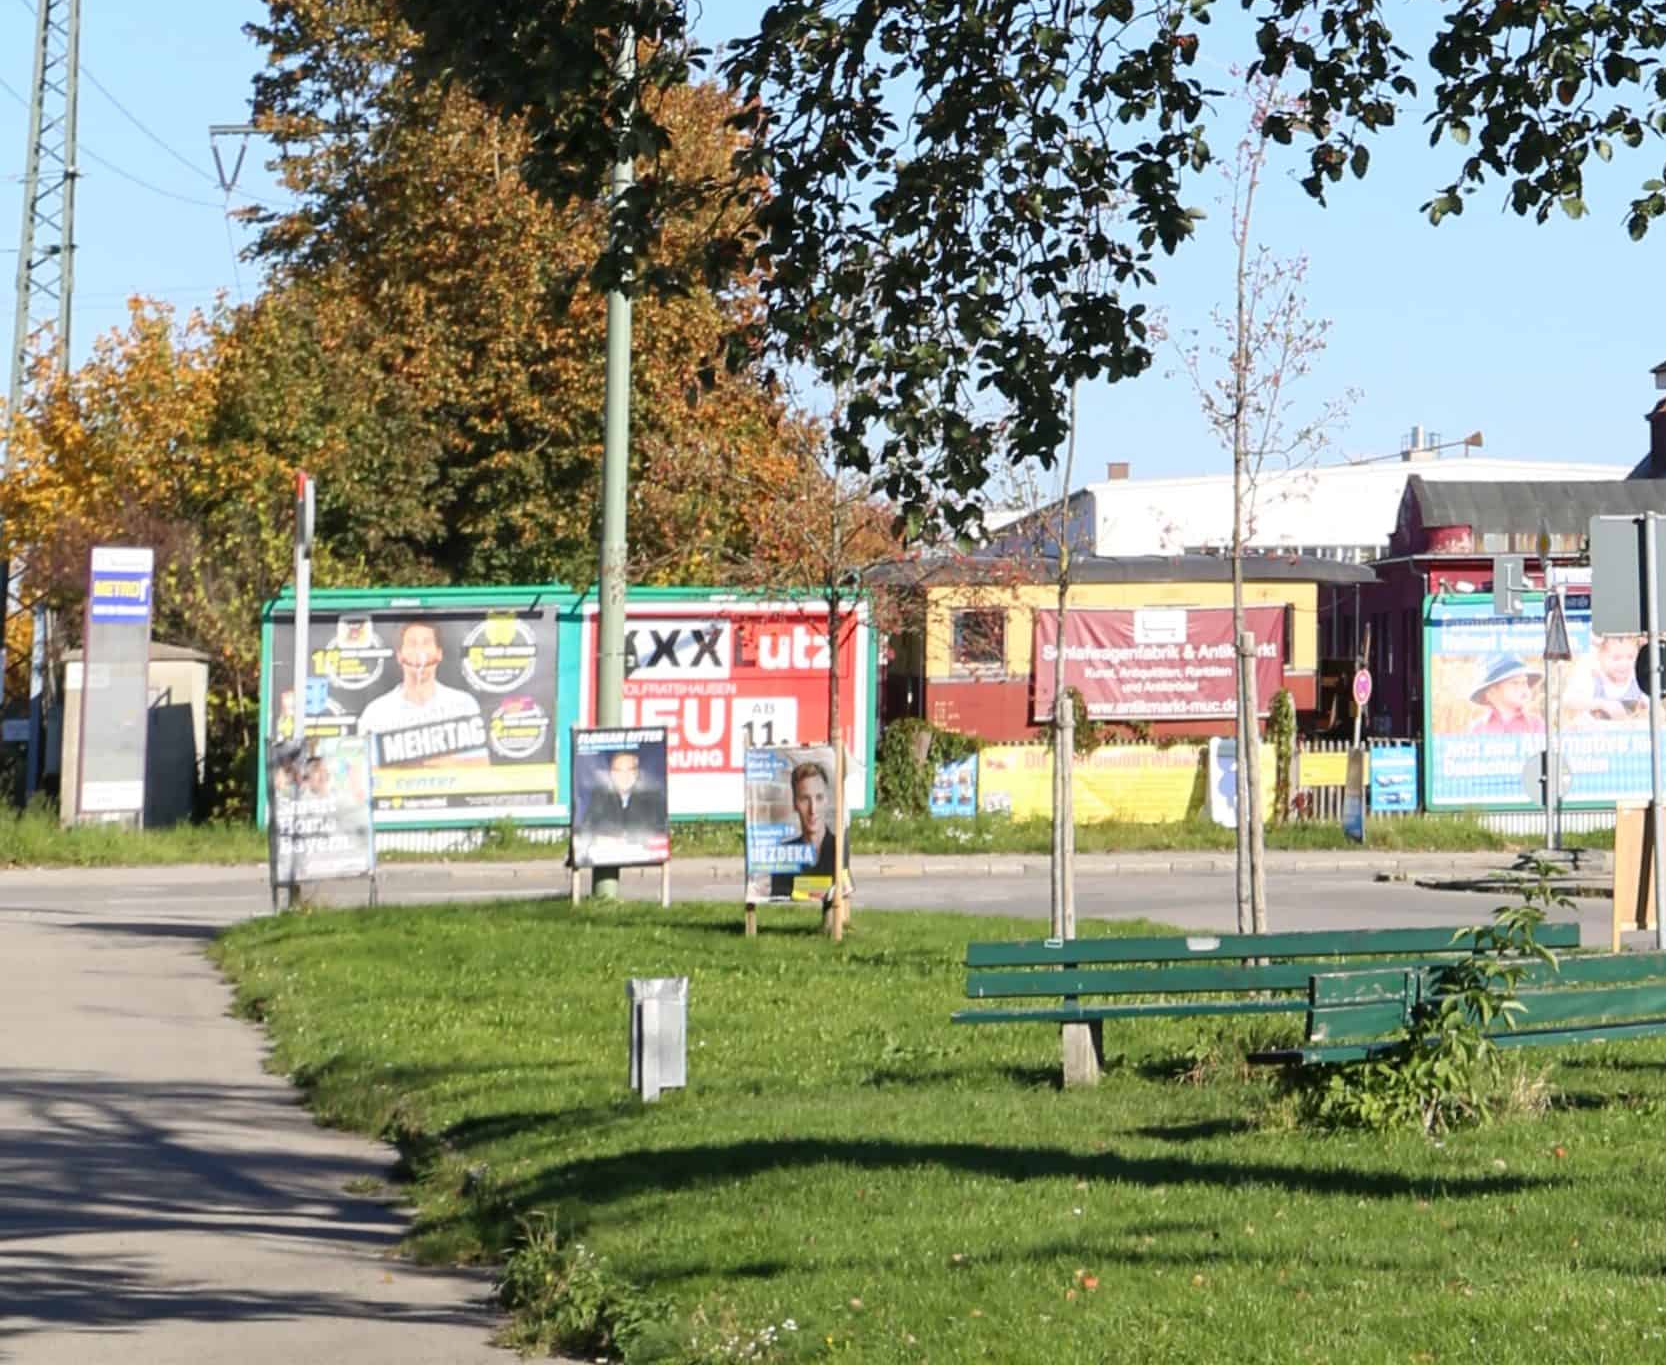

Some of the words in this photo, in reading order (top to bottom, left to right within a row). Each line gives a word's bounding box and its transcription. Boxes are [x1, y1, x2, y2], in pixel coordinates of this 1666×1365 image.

[1183, 645, 1195, 661] &
[1198, 643, 1277, 660] Antikrkt
[624, 682, 737, 695] OLFRATSHAUSEN
[382, 717, 487, 763] MEHRTAG
